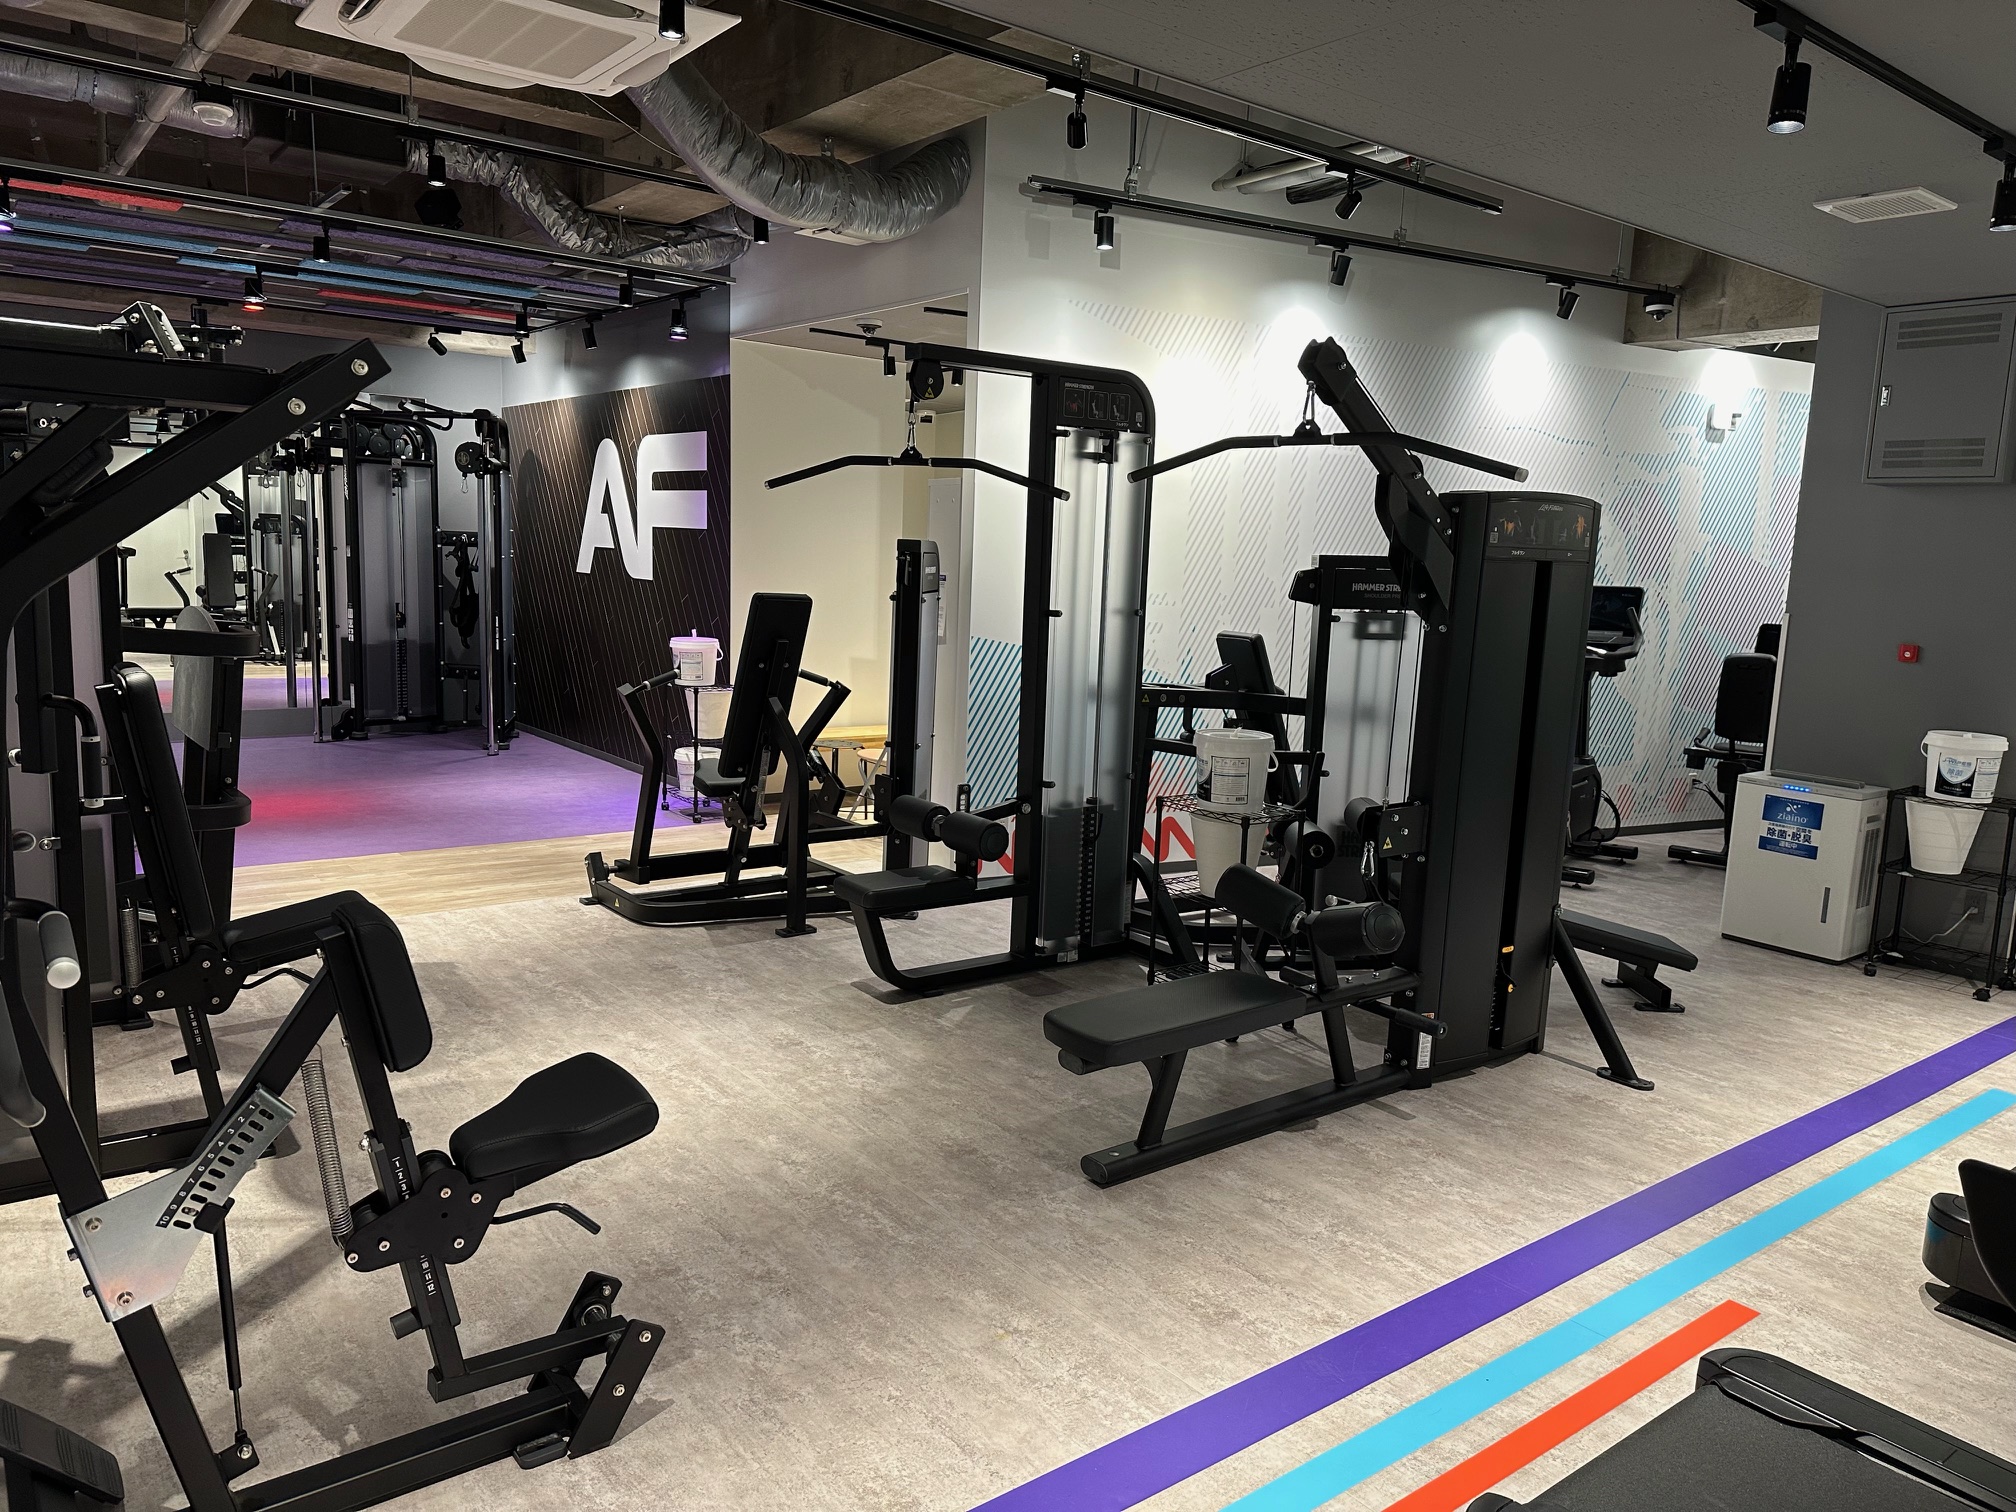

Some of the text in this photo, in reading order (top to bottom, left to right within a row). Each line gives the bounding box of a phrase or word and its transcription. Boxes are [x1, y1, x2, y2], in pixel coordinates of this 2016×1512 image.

[576, 431, 708, 580] AF
[1352, 583, 1385, 592] HAMMER
[1777, 812, 1807, 824] ziaino
[397, 1172, 404, 1180] 2
[400, 1183, 407, 1191] 3
[159, 1215, 170, 1226] 10
[421, 1261, 429, 1270] 10
[424, 1272, 432, 1281] 11
[427, 1283, 435, 1292] 12
